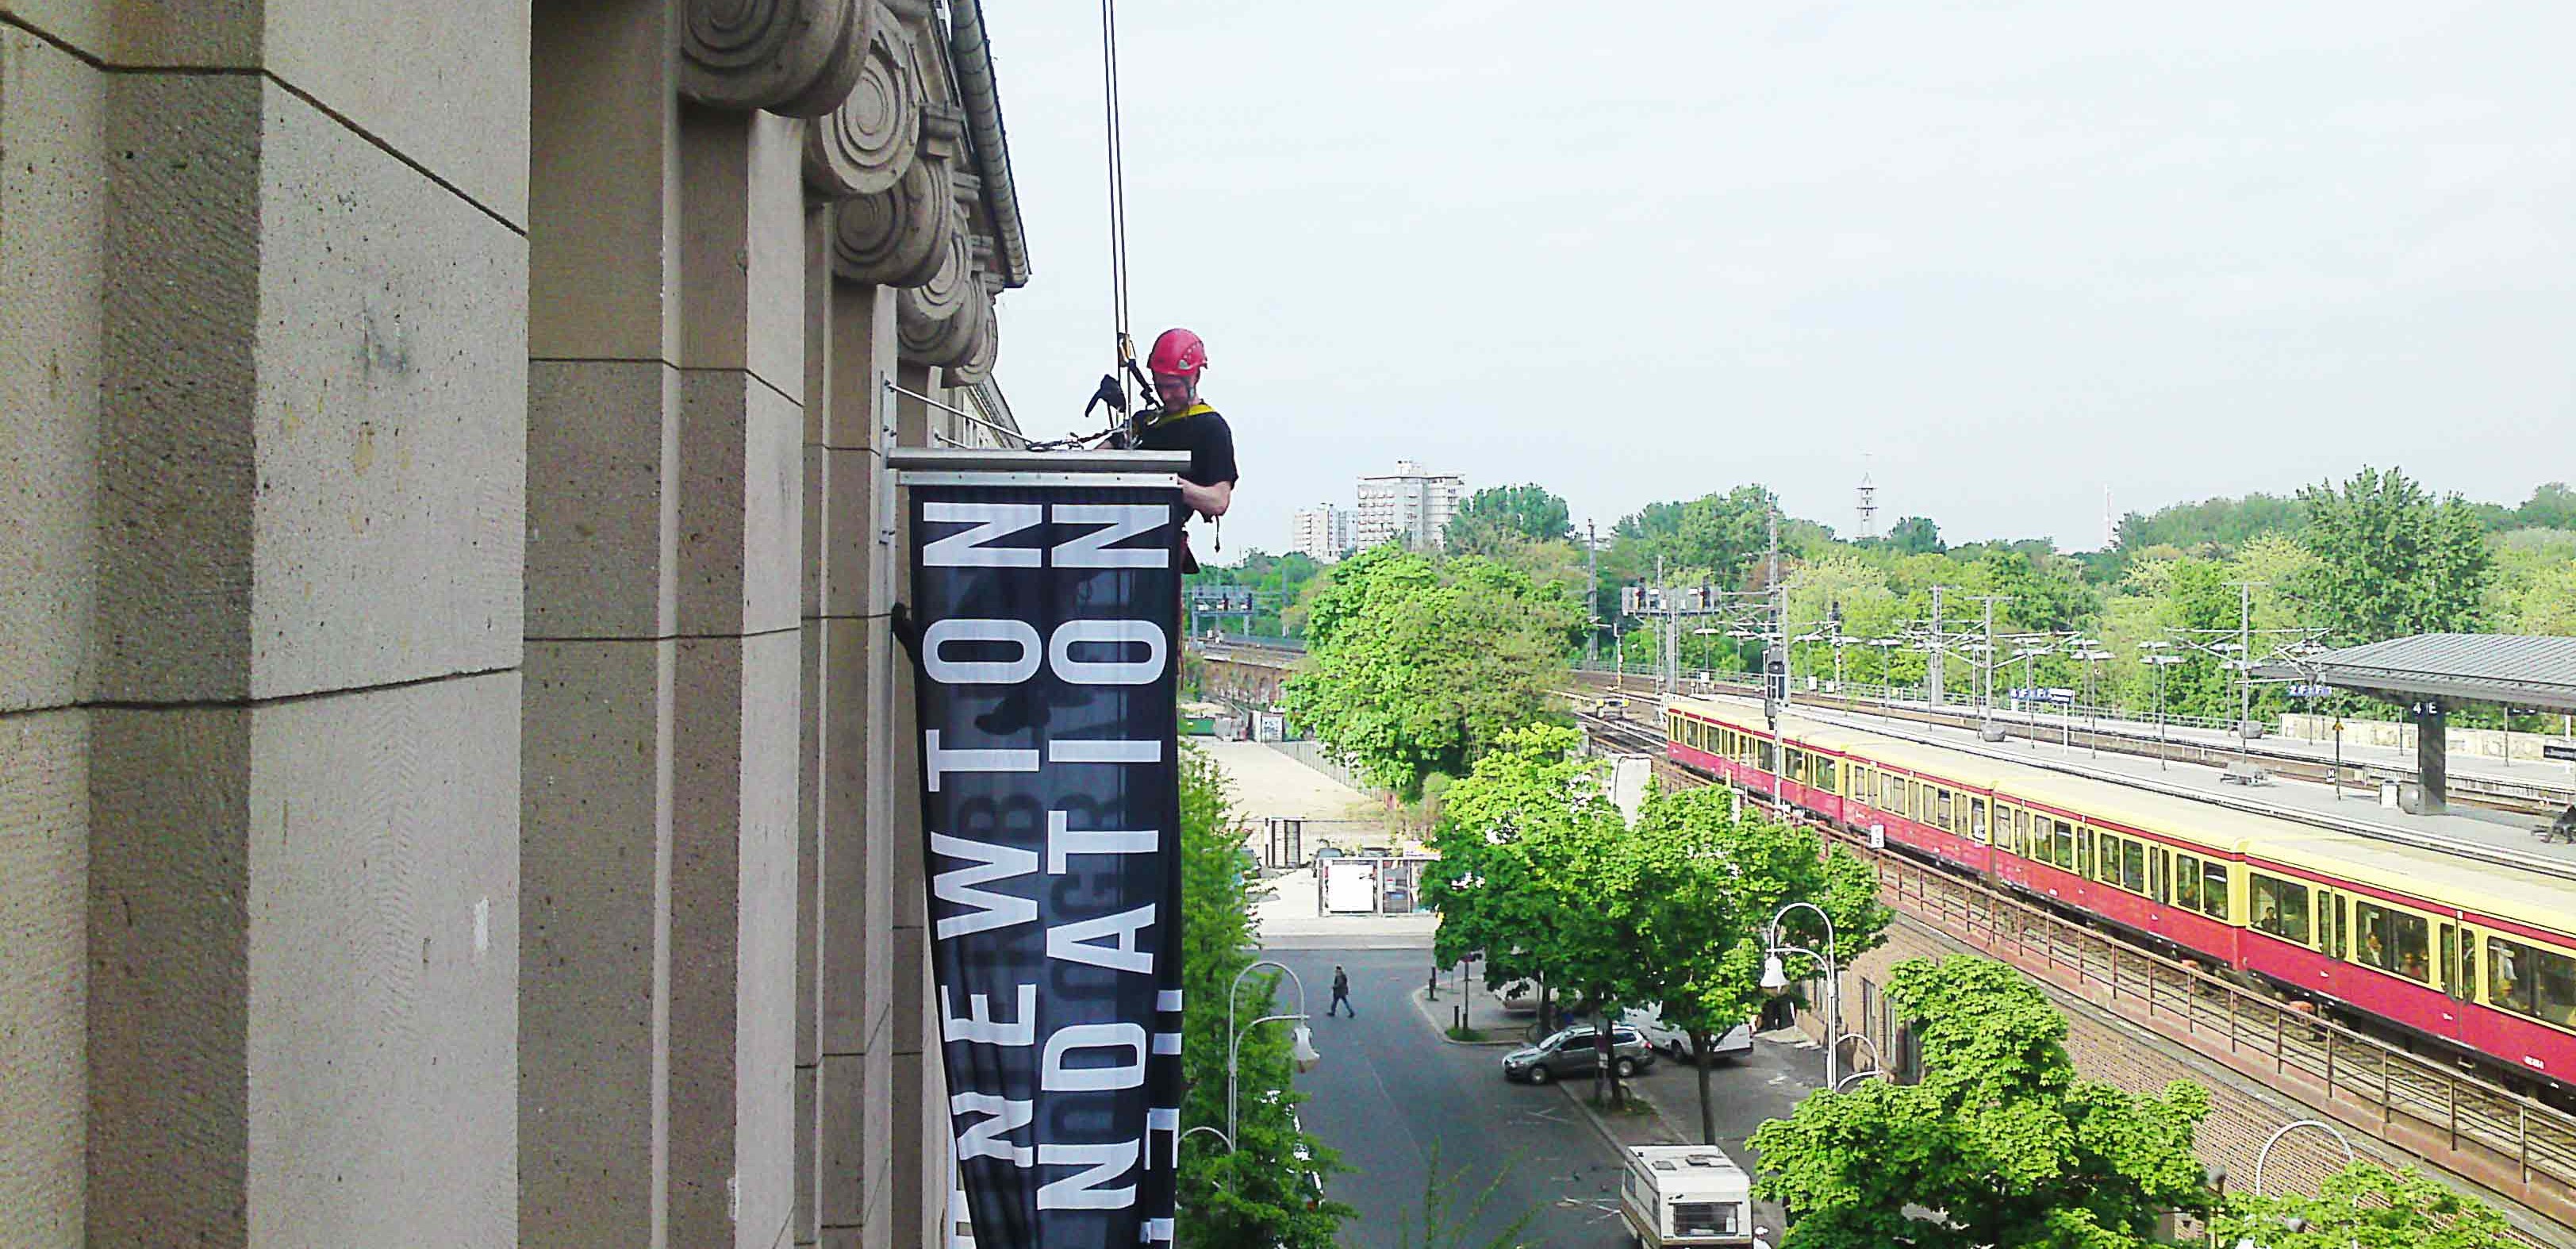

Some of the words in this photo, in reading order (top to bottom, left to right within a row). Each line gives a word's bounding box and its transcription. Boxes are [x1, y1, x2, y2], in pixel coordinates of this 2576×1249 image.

[923, 502, 1042, 1167] NEWTON
[2413, 701, 2422, 714] 4
[2428, 701, 2437, 714] E
